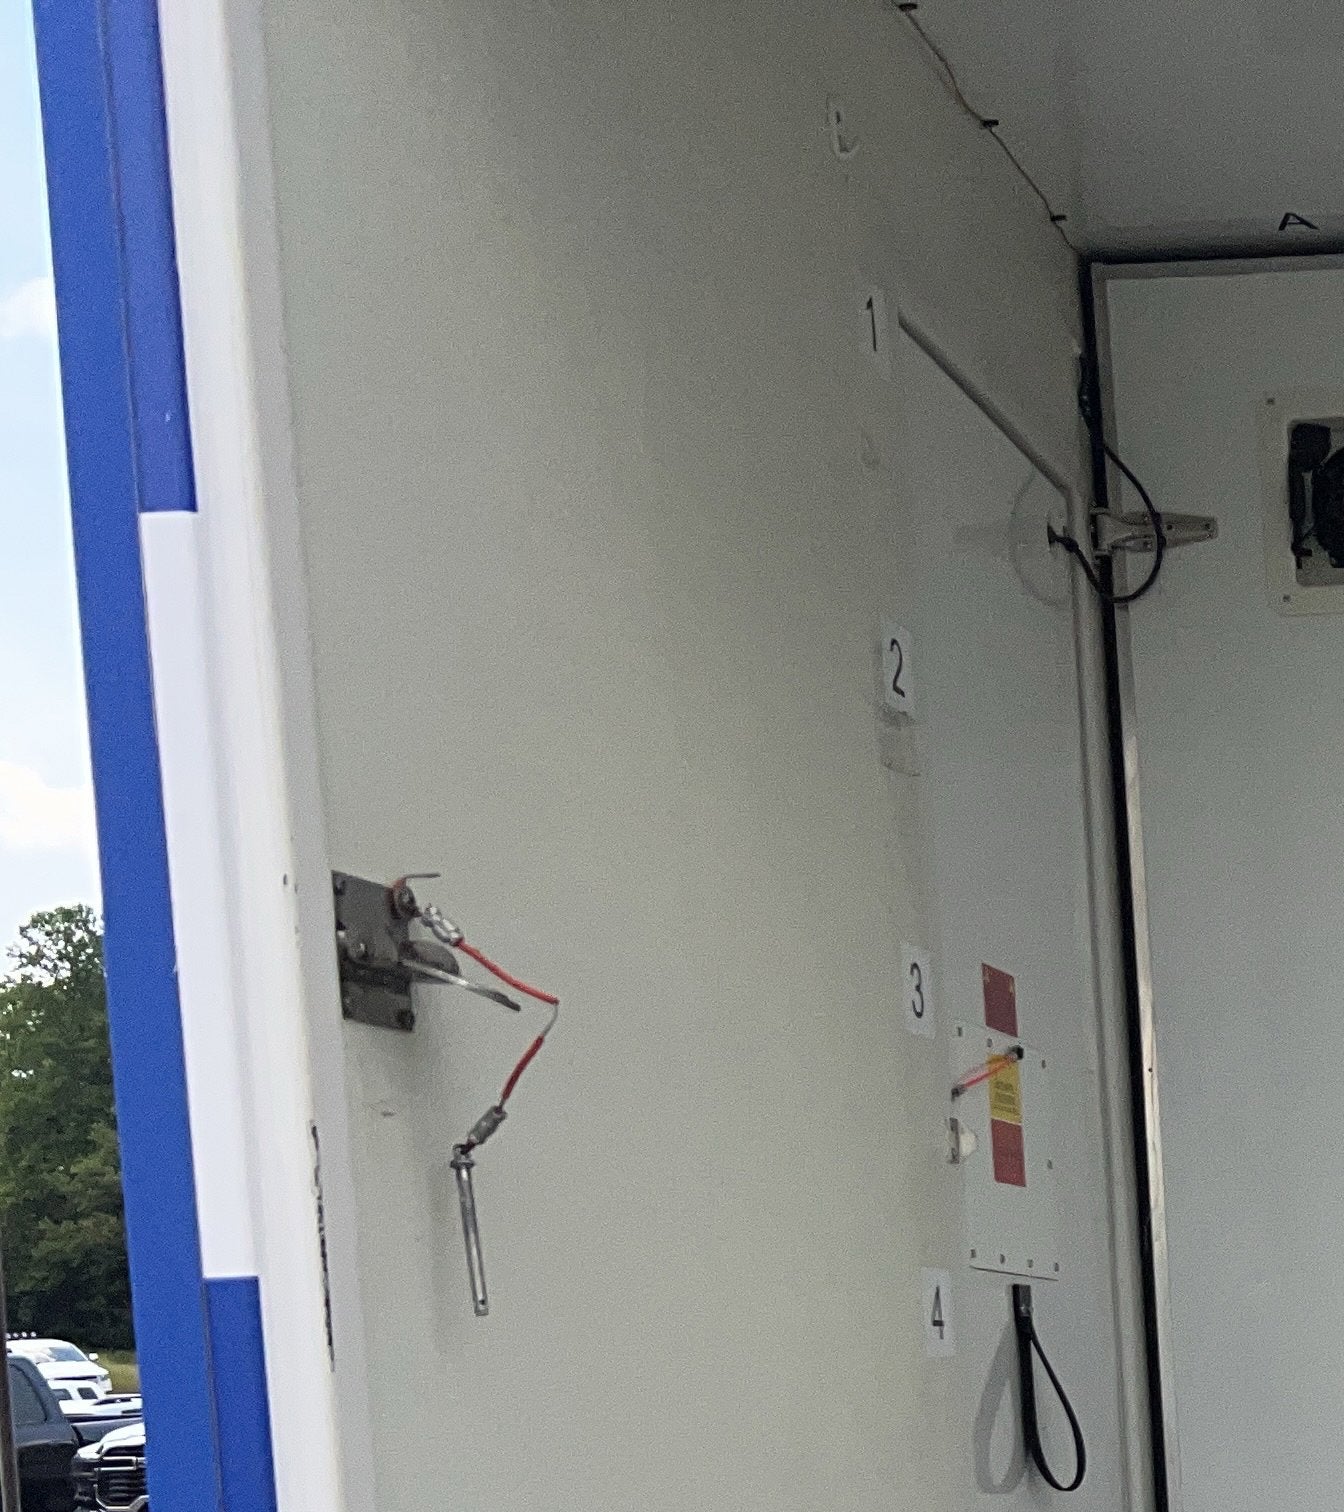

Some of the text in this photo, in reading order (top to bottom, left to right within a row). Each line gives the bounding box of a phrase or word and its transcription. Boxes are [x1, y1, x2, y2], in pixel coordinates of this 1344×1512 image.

[1277, 211, 1320, 232] A
[888, 637, 907, 699] 2
[908, 961, 926, 1020] 3
[930, 1284, 946, 1341] 4
